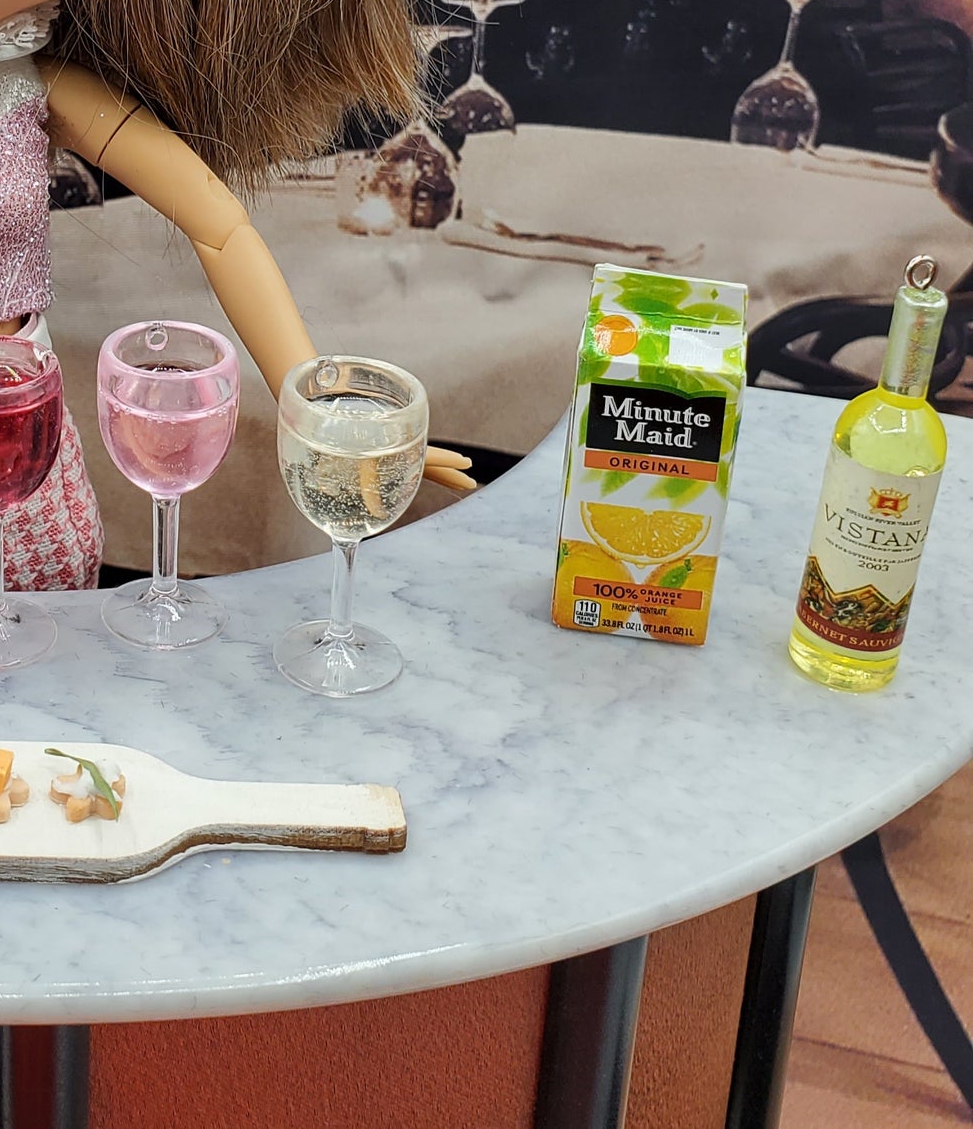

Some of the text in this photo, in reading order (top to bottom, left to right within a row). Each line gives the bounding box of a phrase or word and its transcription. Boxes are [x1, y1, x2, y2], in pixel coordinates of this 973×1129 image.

[601, 395, 711, 428] Minute
[614, 419, 694, 449] Maid
[609, 457, 691, 475] ORIGINAL
[858, 560, 890, 572] 2003
[593, 583, 639, 600] 100%
[640, 588, 683, 599] ORANGE
[579, 601, 598, 613] 110
[645, 597, 676, 606] JUICE
[611, 602, 668, 617] FROM CONCENTRATE
[625, 622, 636, 630] OZ
